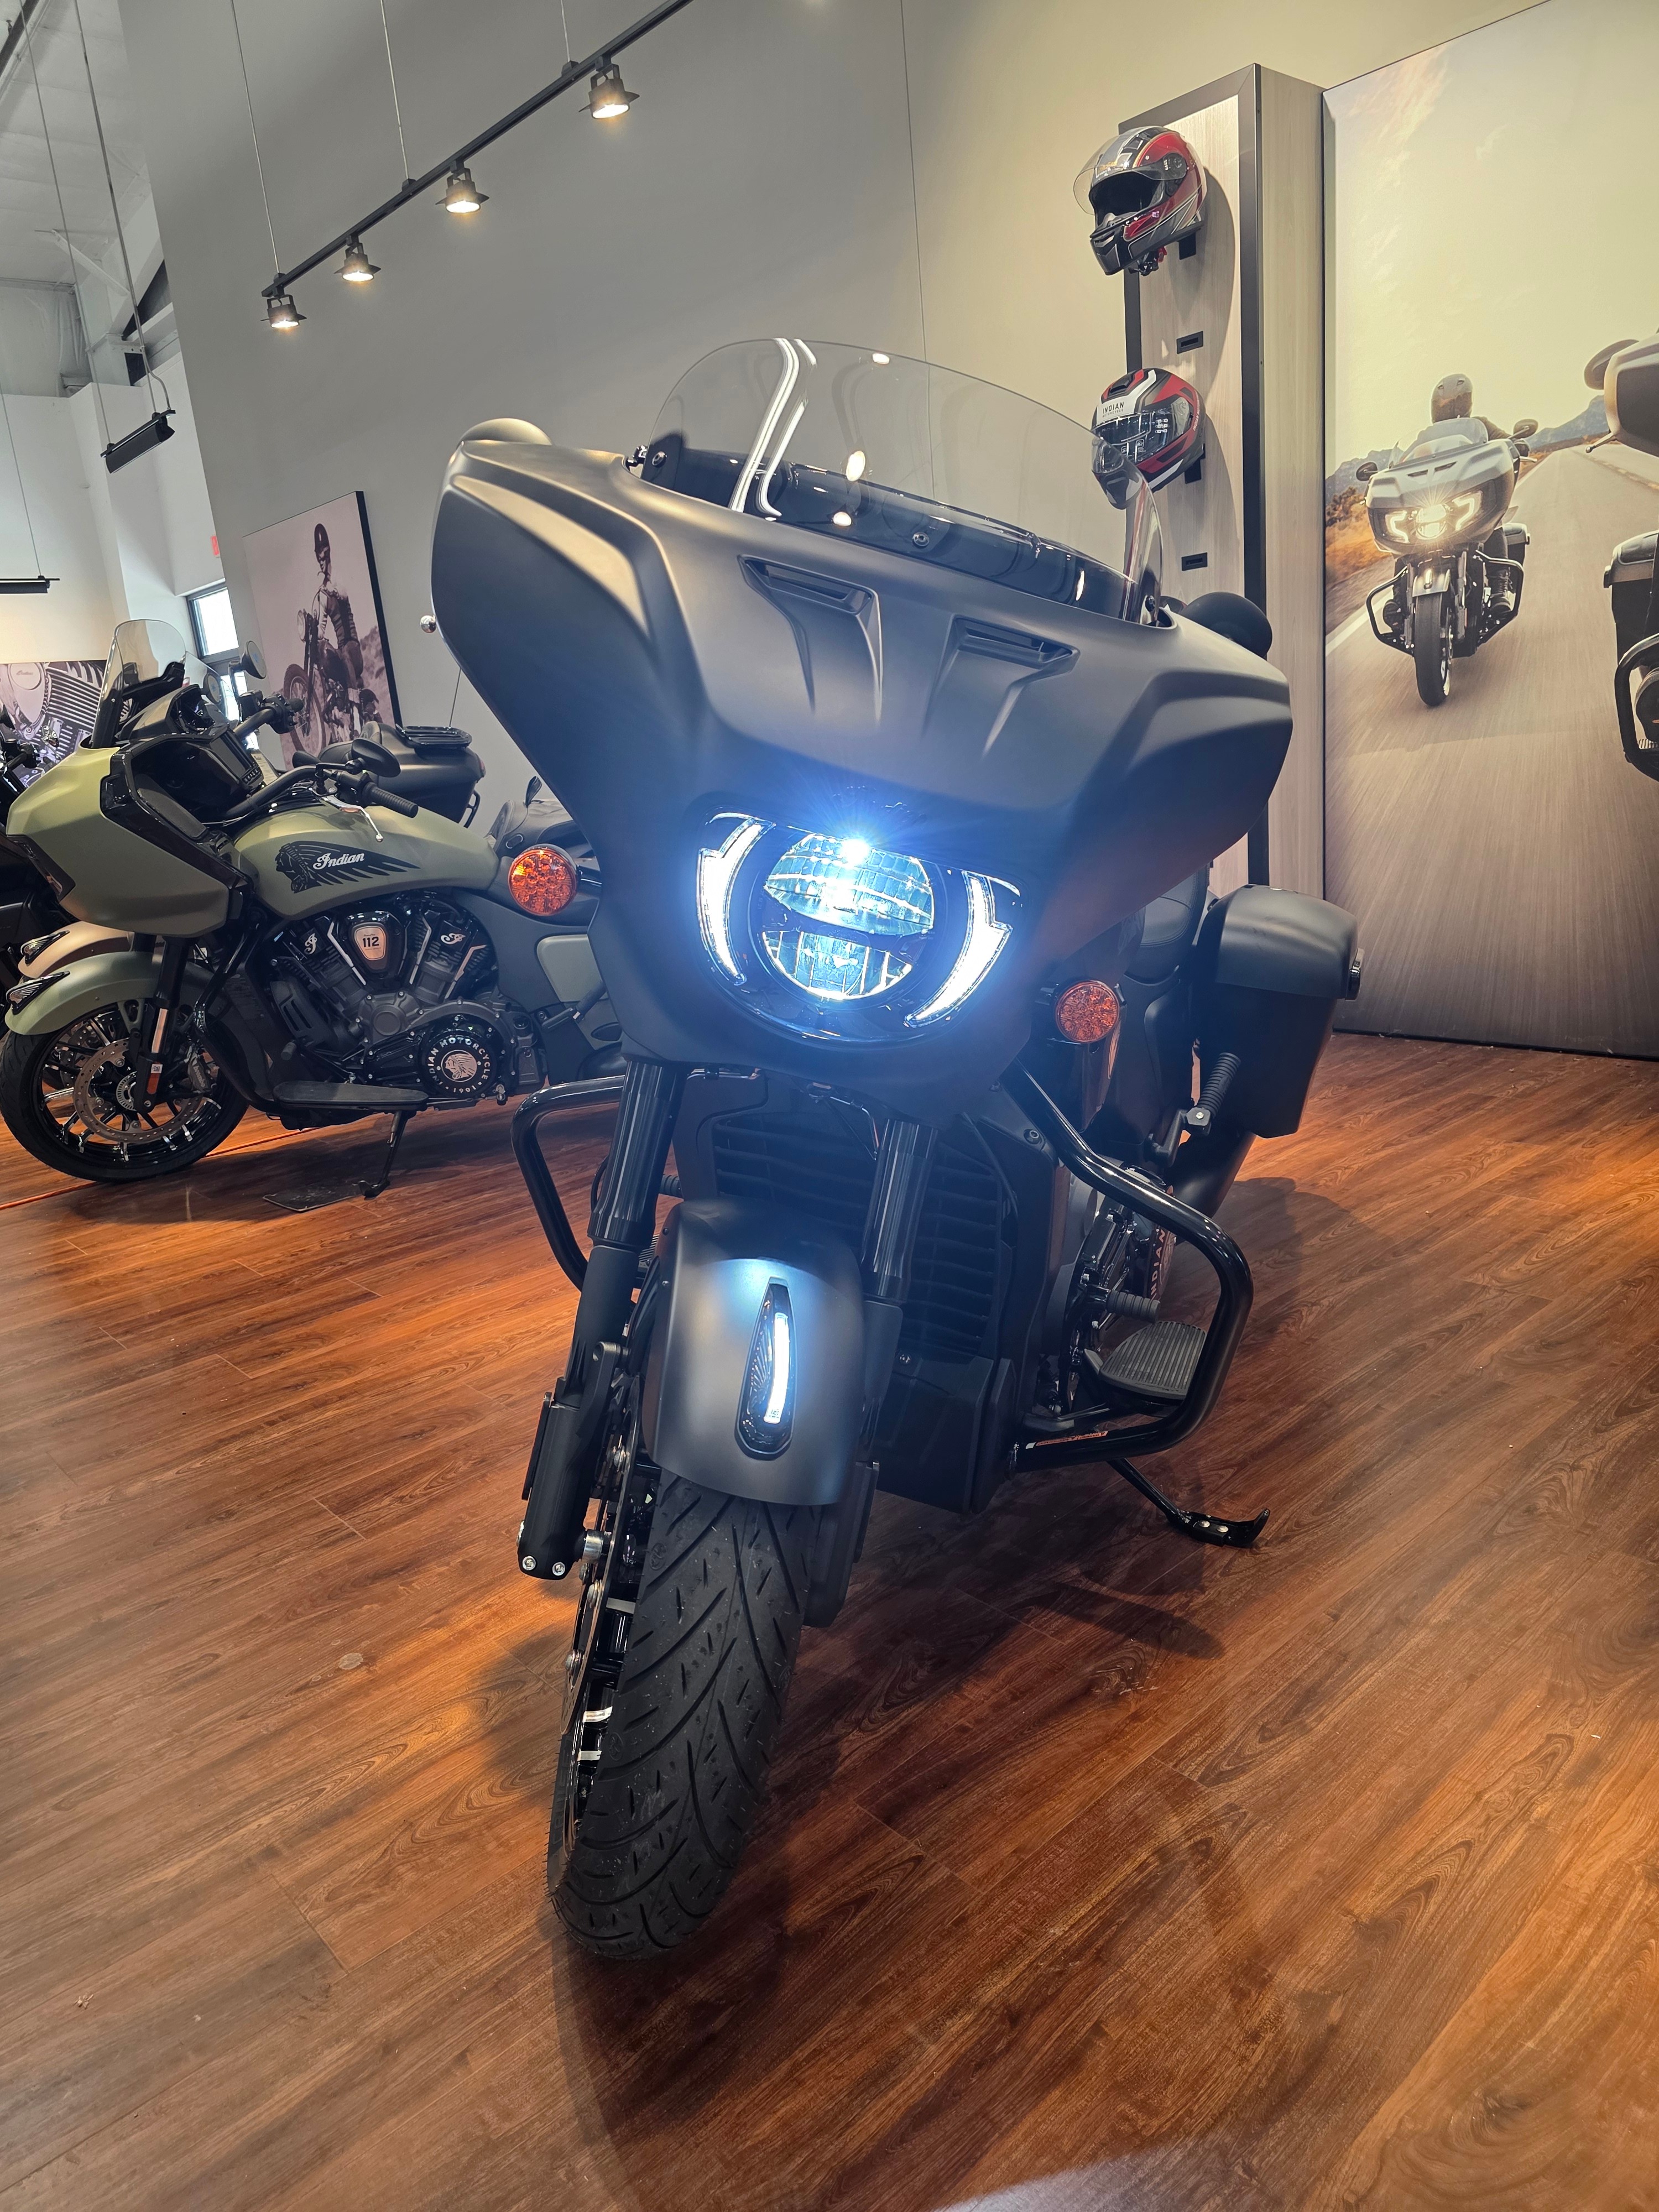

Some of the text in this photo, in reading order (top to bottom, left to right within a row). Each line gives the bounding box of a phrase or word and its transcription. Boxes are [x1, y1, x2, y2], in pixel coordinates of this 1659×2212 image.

[1102, 401, 1124, 415] INDIAN
[312, 853, 365, 870] Indian
[362, 936, 379, 948] 112
[427, 1037, 491, 1085] INDIAN MOTORCYCLE
[193, 1065, 206, 1087] brembo
[453, 1085, 477, 1093] 1901
[1150, 1229, 1166, 1300] INDIAN
